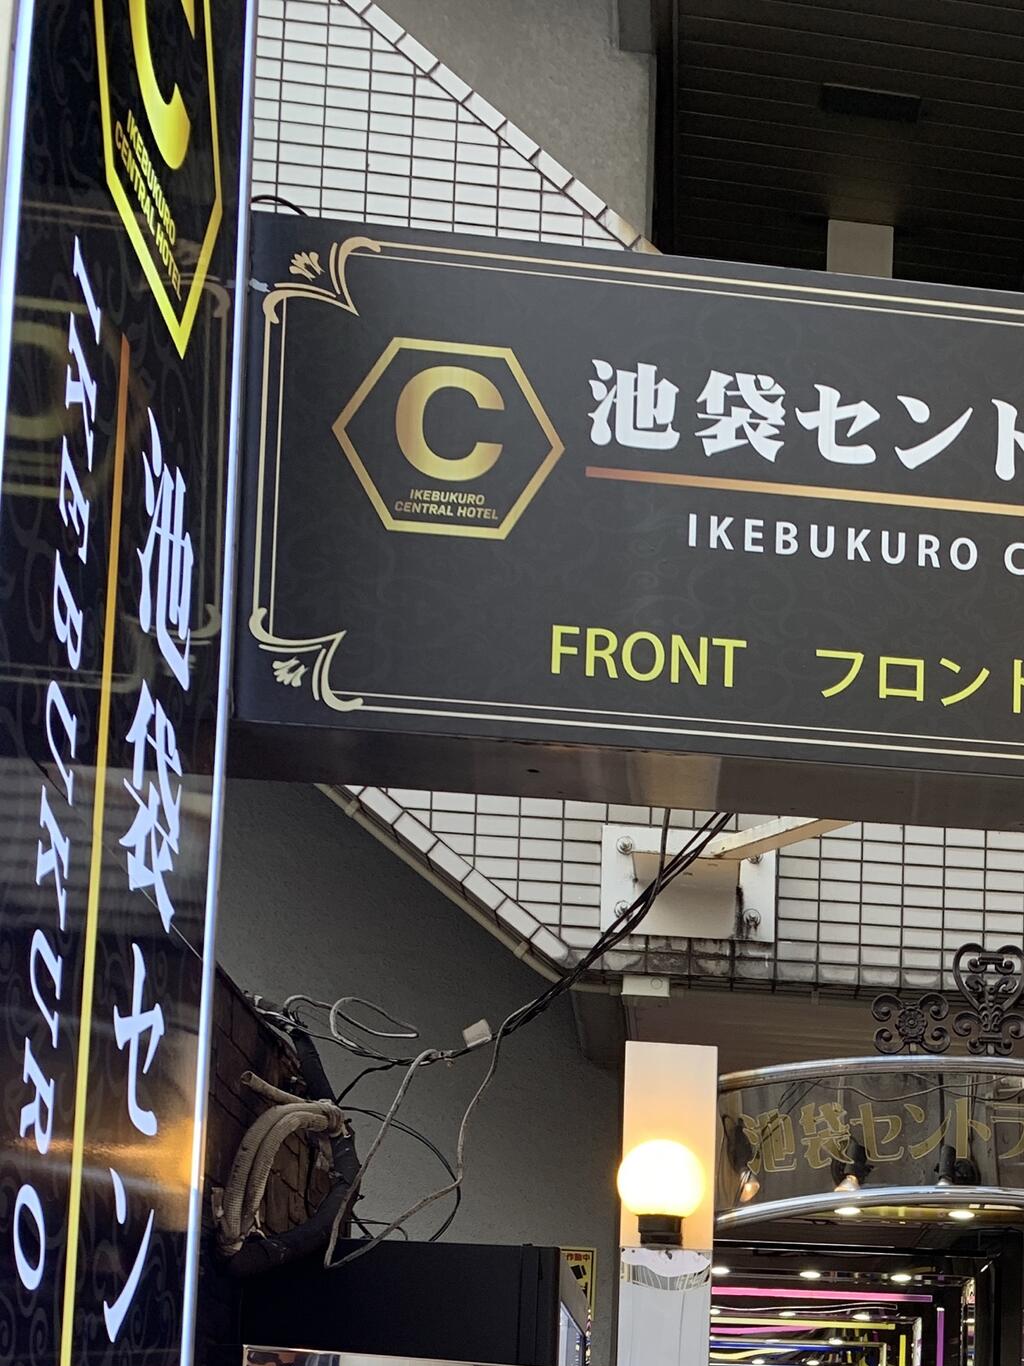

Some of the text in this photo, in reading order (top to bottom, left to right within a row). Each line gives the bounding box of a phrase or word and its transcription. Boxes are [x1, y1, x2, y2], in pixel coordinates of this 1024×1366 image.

[127, 108, 176, 245] IKEBUKURO
[115, 120, 182, 301] CENTRAL HOTEL
[395, 365, 505, 482] C
[394, 500, 499, 521] CENTRAL HOTEL
[409, 488, 486, 506] IKEBUKURO
[687, 512, 979, 573] IKEBUKURO
[550, 624, 748, 689] FRONT
